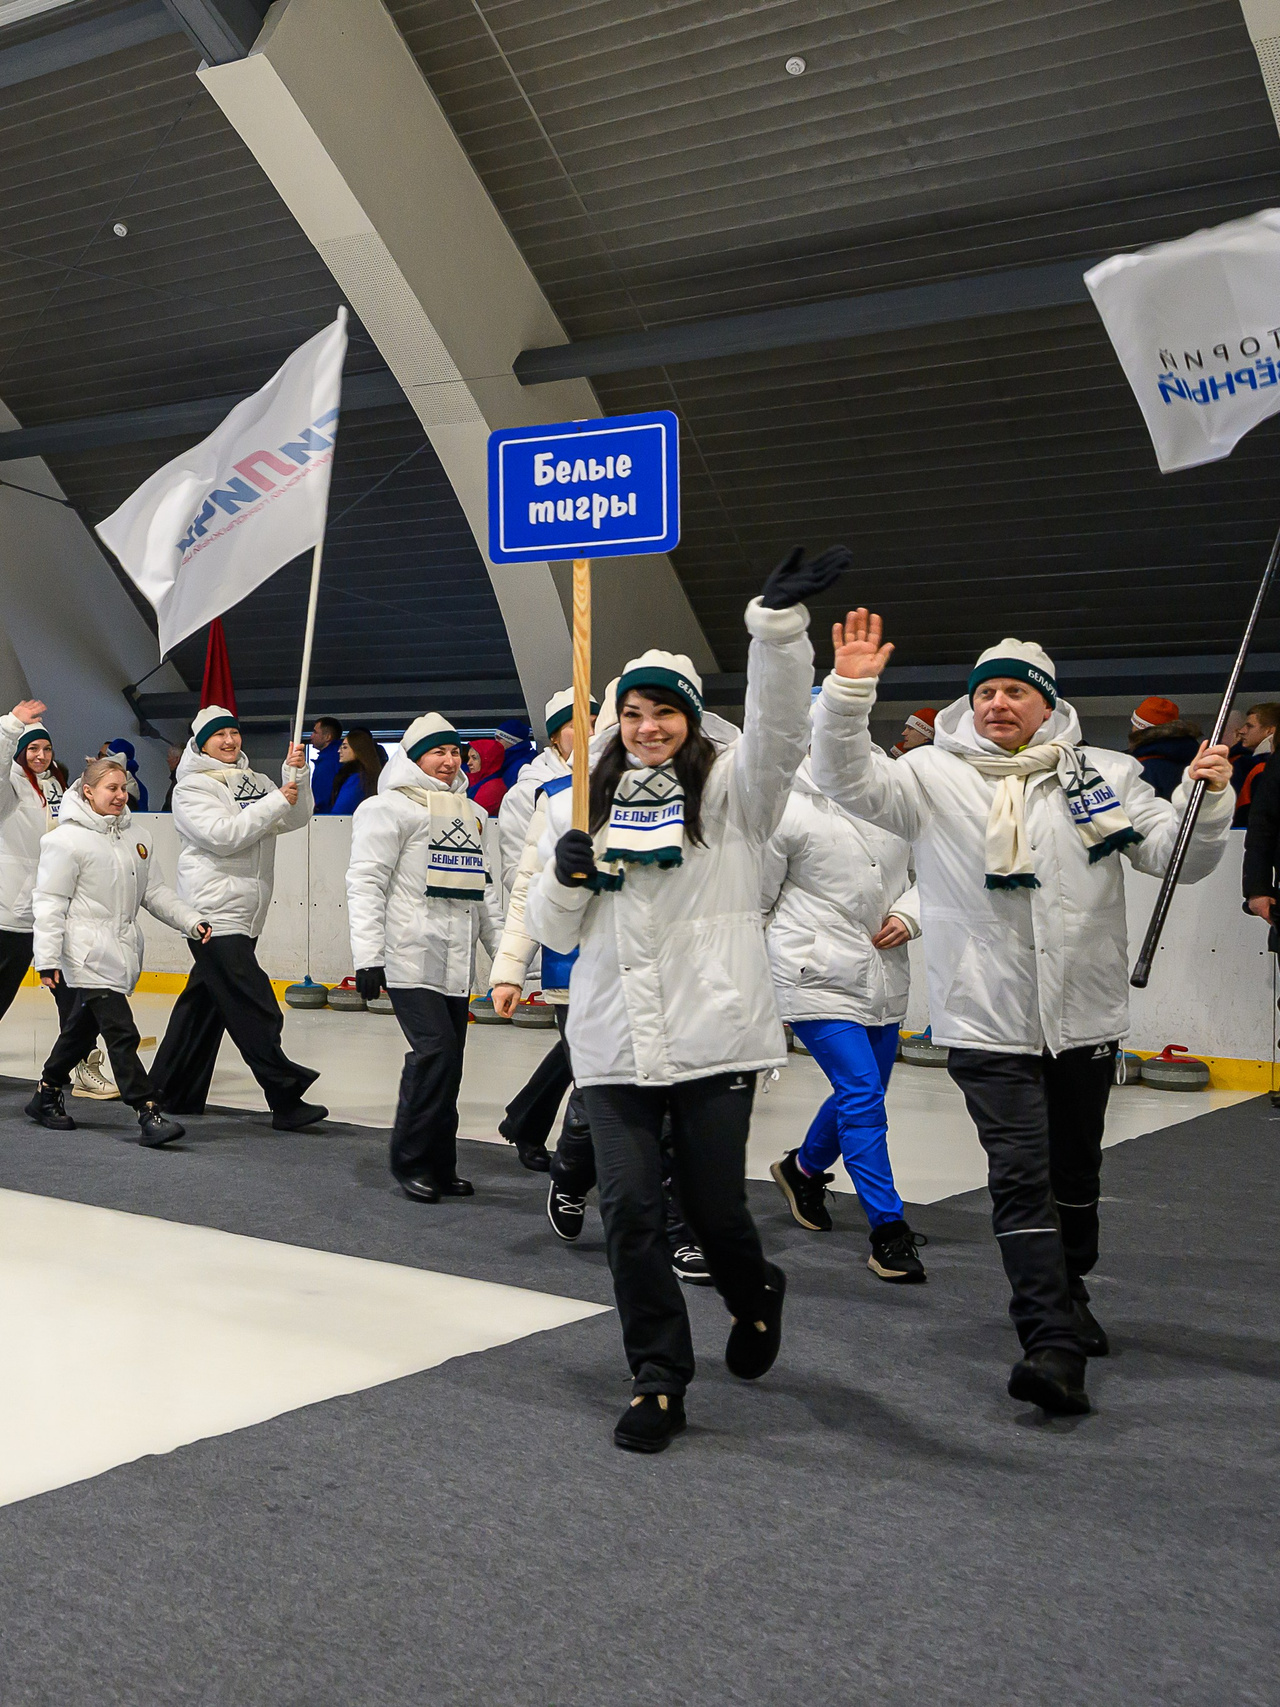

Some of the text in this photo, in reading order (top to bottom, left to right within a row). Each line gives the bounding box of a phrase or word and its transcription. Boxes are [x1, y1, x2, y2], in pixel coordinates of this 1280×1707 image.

[533, 452, 633, 487] Белые
[528, 492, 637, 530] тигры
[614, 809, 660, 823] БЕЛЫЕ
[431, 853, 483, 867] БЕЛЫЕ ТИГРЫ
